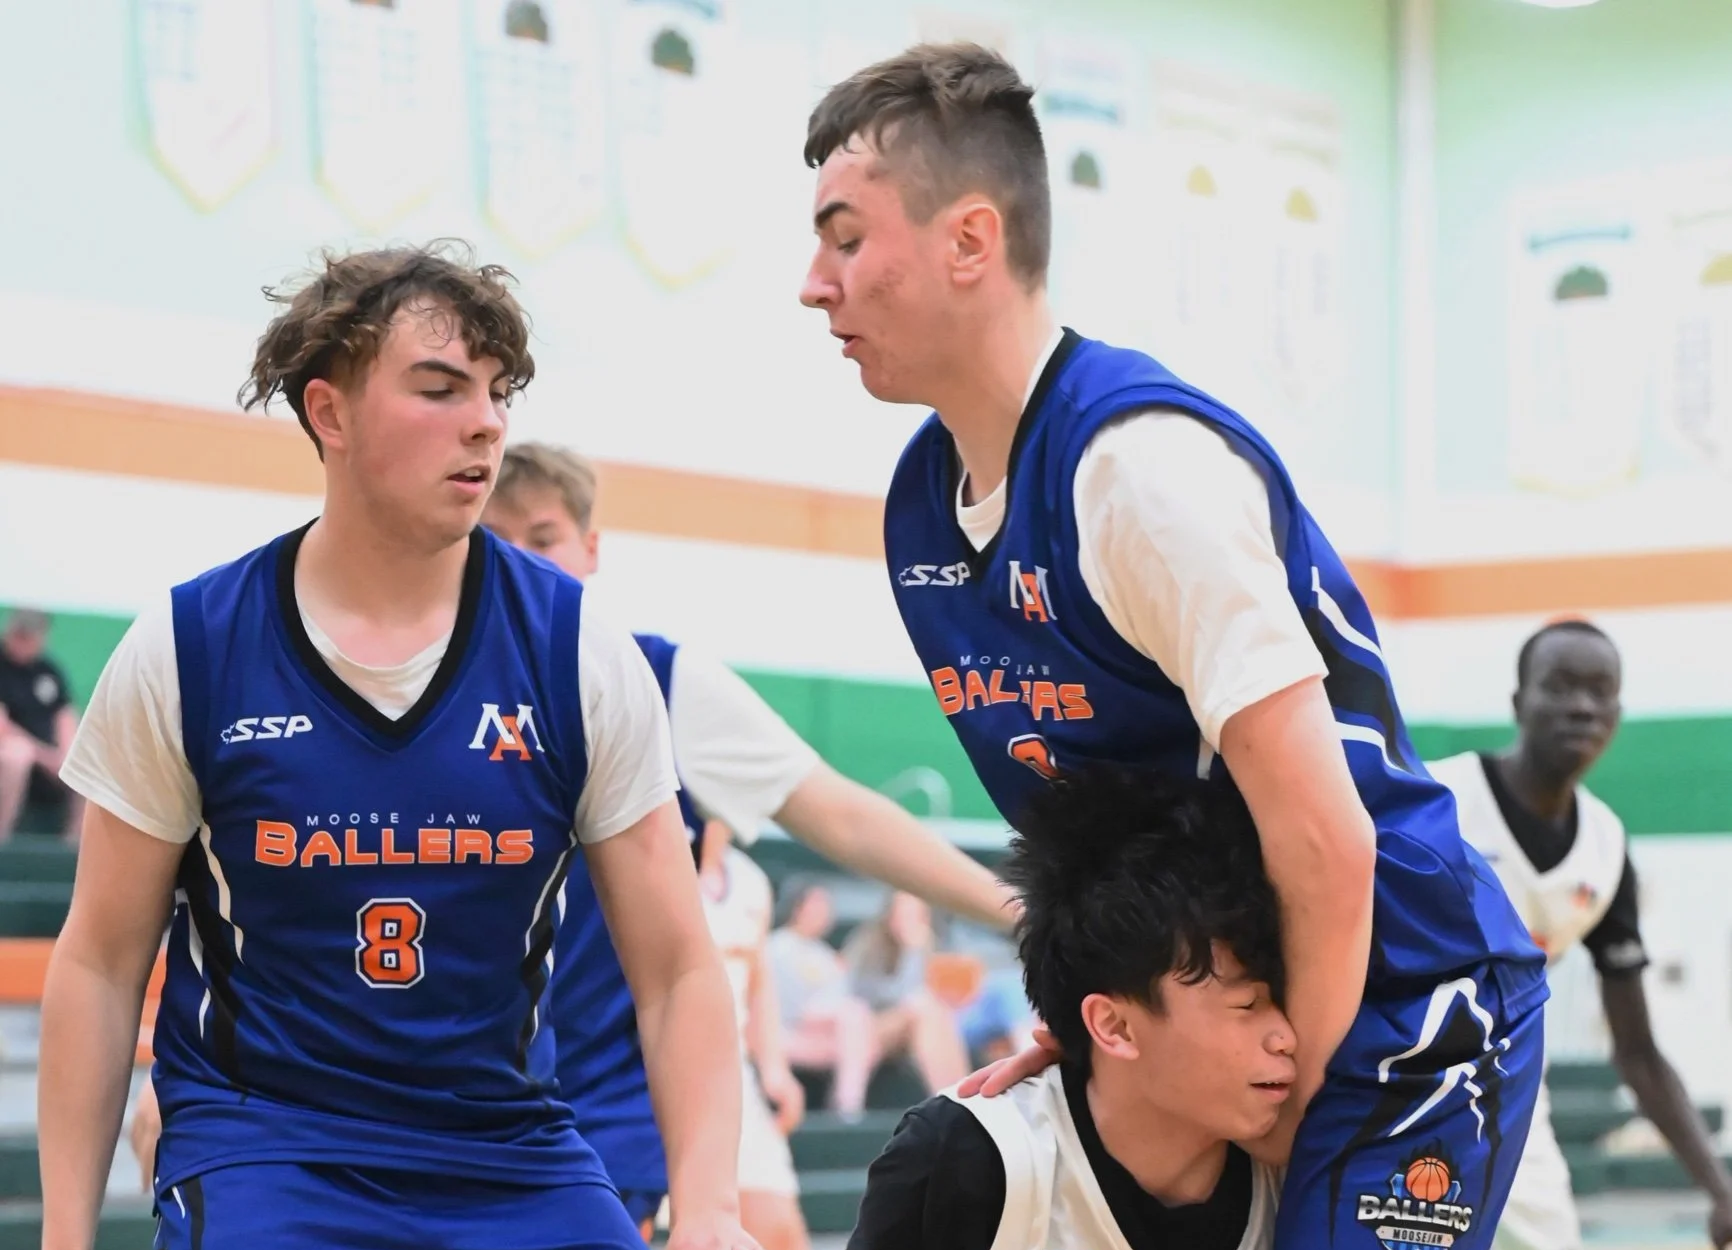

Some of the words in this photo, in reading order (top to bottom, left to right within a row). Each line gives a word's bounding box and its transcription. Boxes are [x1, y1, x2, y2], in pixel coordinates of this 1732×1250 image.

[905, 561, 970, 587] SSP
[960, 655, 1011, 667] MOO
[931, 666, 1095, 721] BALRS
[230, 714, 314, 744] SSP
[306, 812, 400, 827] MOOSE
[426, 813, 483, 825] JAW
[255, 819, 534, 867] BALLERS
[355, 897, 427, 989] 8
[1357, 1194, 1473, 1232] BALLERS
